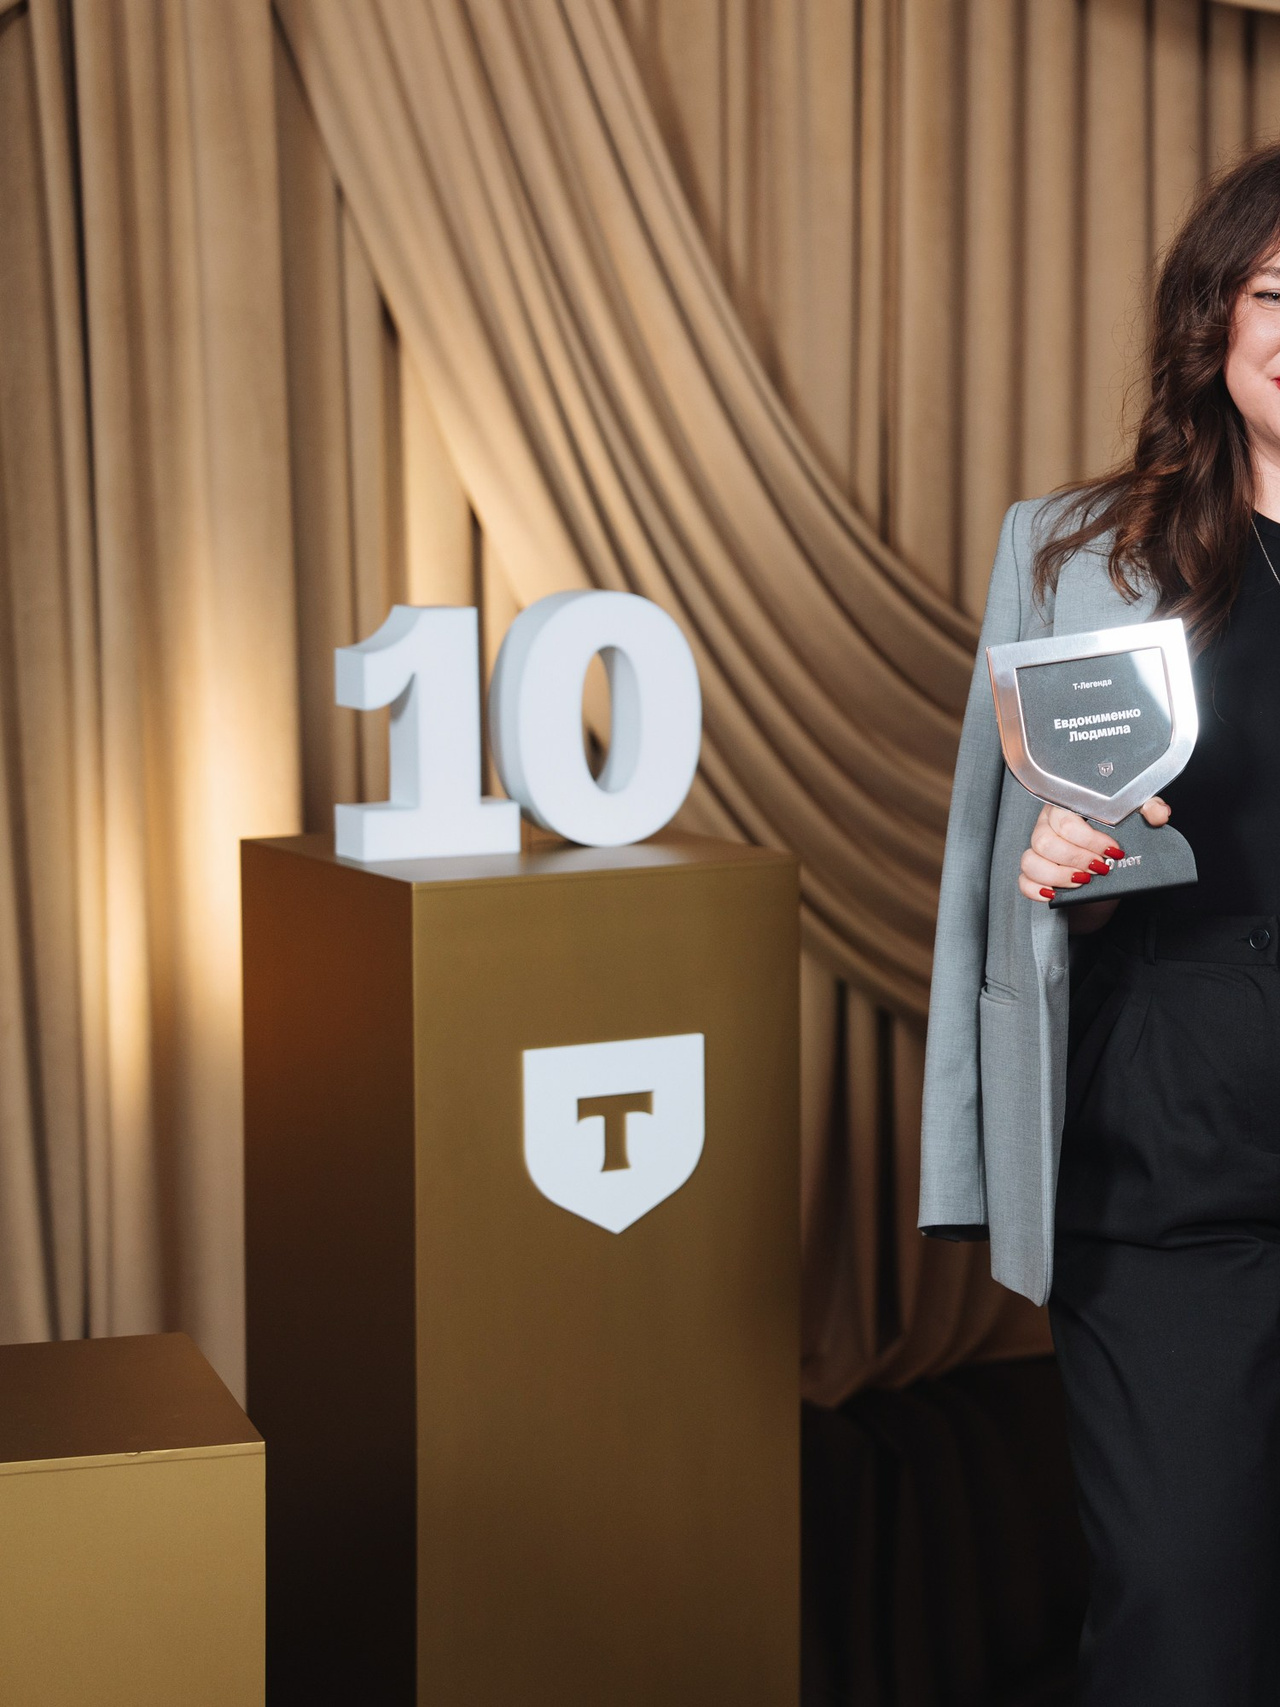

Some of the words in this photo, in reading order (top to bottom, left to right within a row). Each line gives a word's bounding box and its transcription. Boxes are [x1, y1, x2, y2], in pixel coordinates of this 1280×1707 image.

[1072, 679, 1113, 690] Т-Легенда
[335, 589, 701, 862] 10
[1053, 708, 1141, 730] Евдокименко
[1069, 724, 1131, 742] Людмила
[576, 1089, 655, 1173] Т
